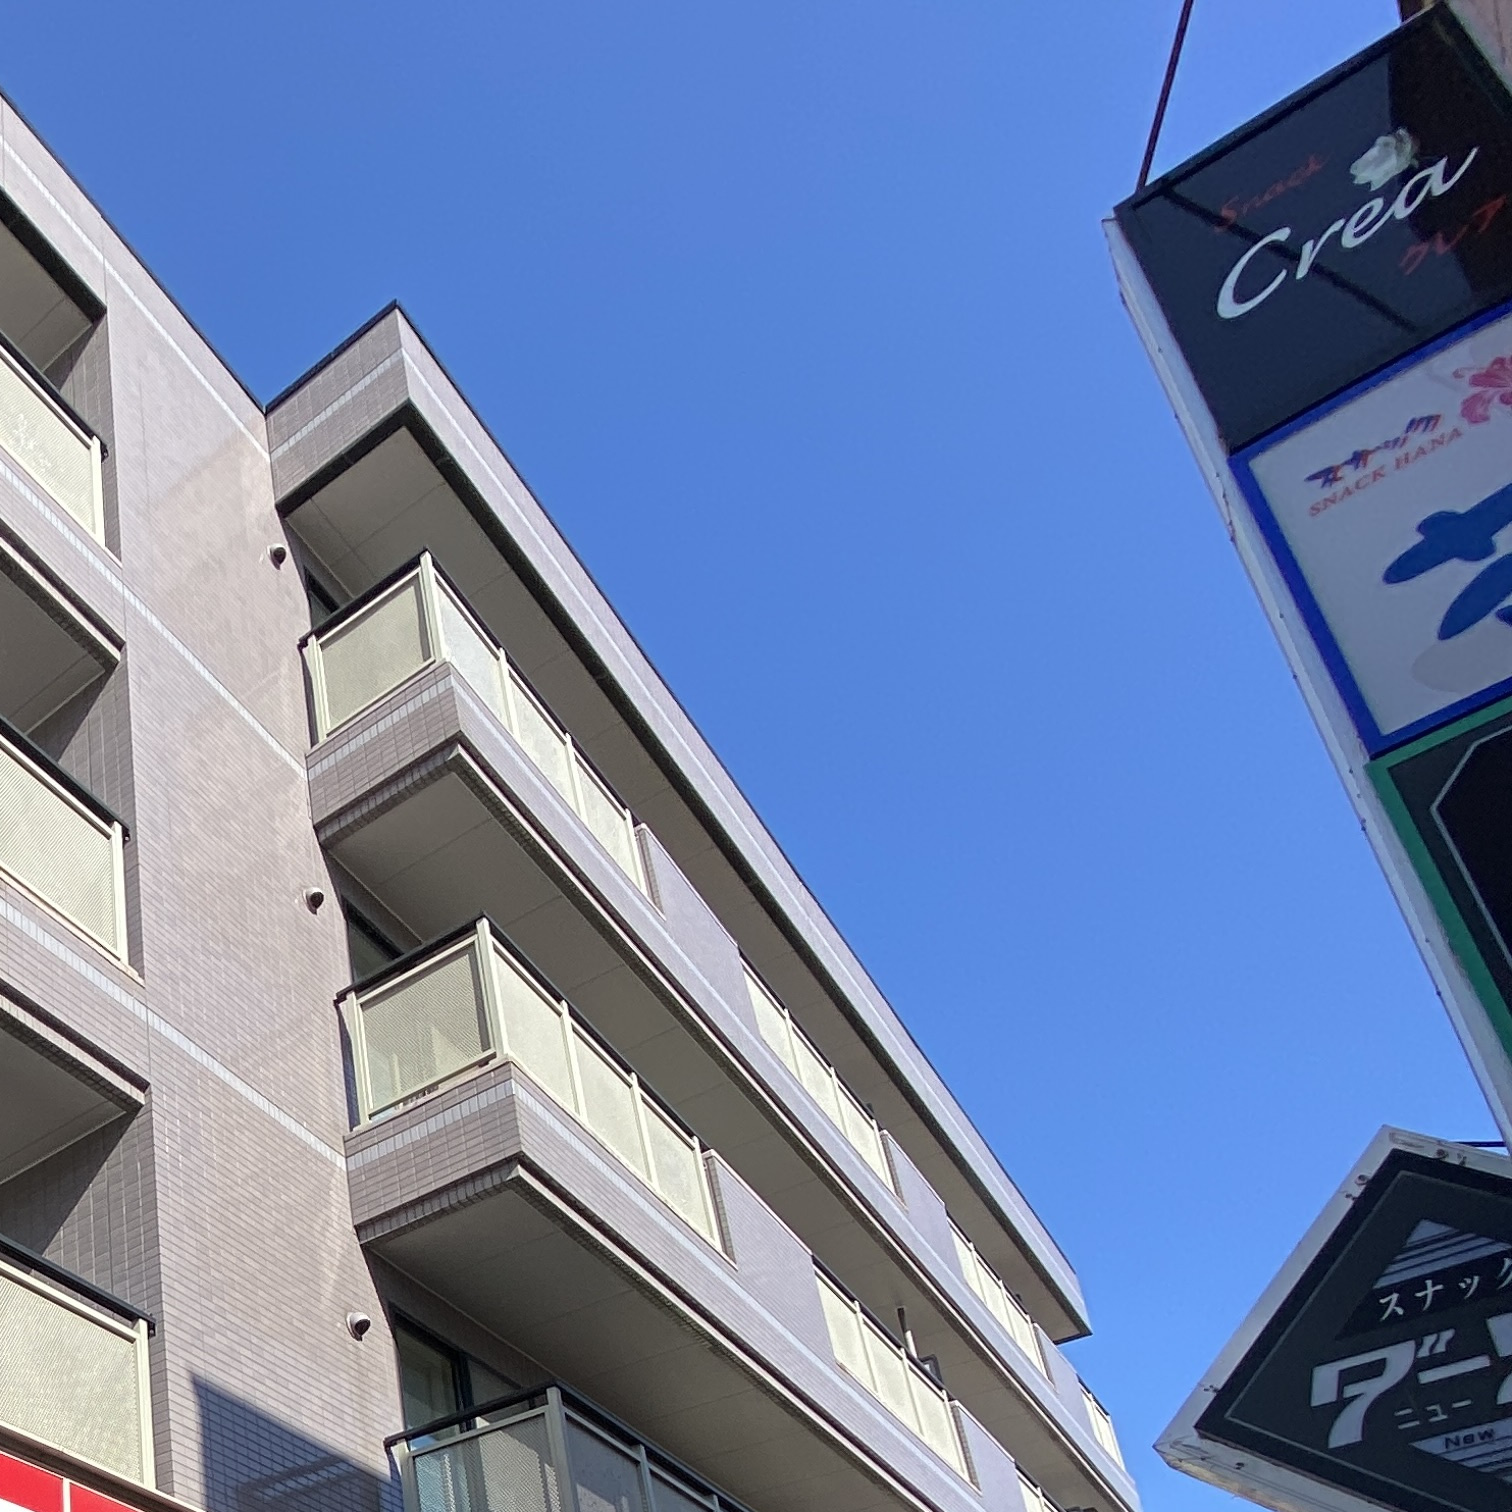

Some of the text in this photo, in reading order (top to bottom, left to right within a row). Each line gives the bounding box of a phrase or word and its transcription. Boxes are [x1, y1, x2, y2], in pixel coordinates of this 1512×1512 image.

[1216, 146, 1480, 319] Crea
[1308, 427, 1464, 519] SNACK HANA
[1444, 1427, 1496, 1450] New
